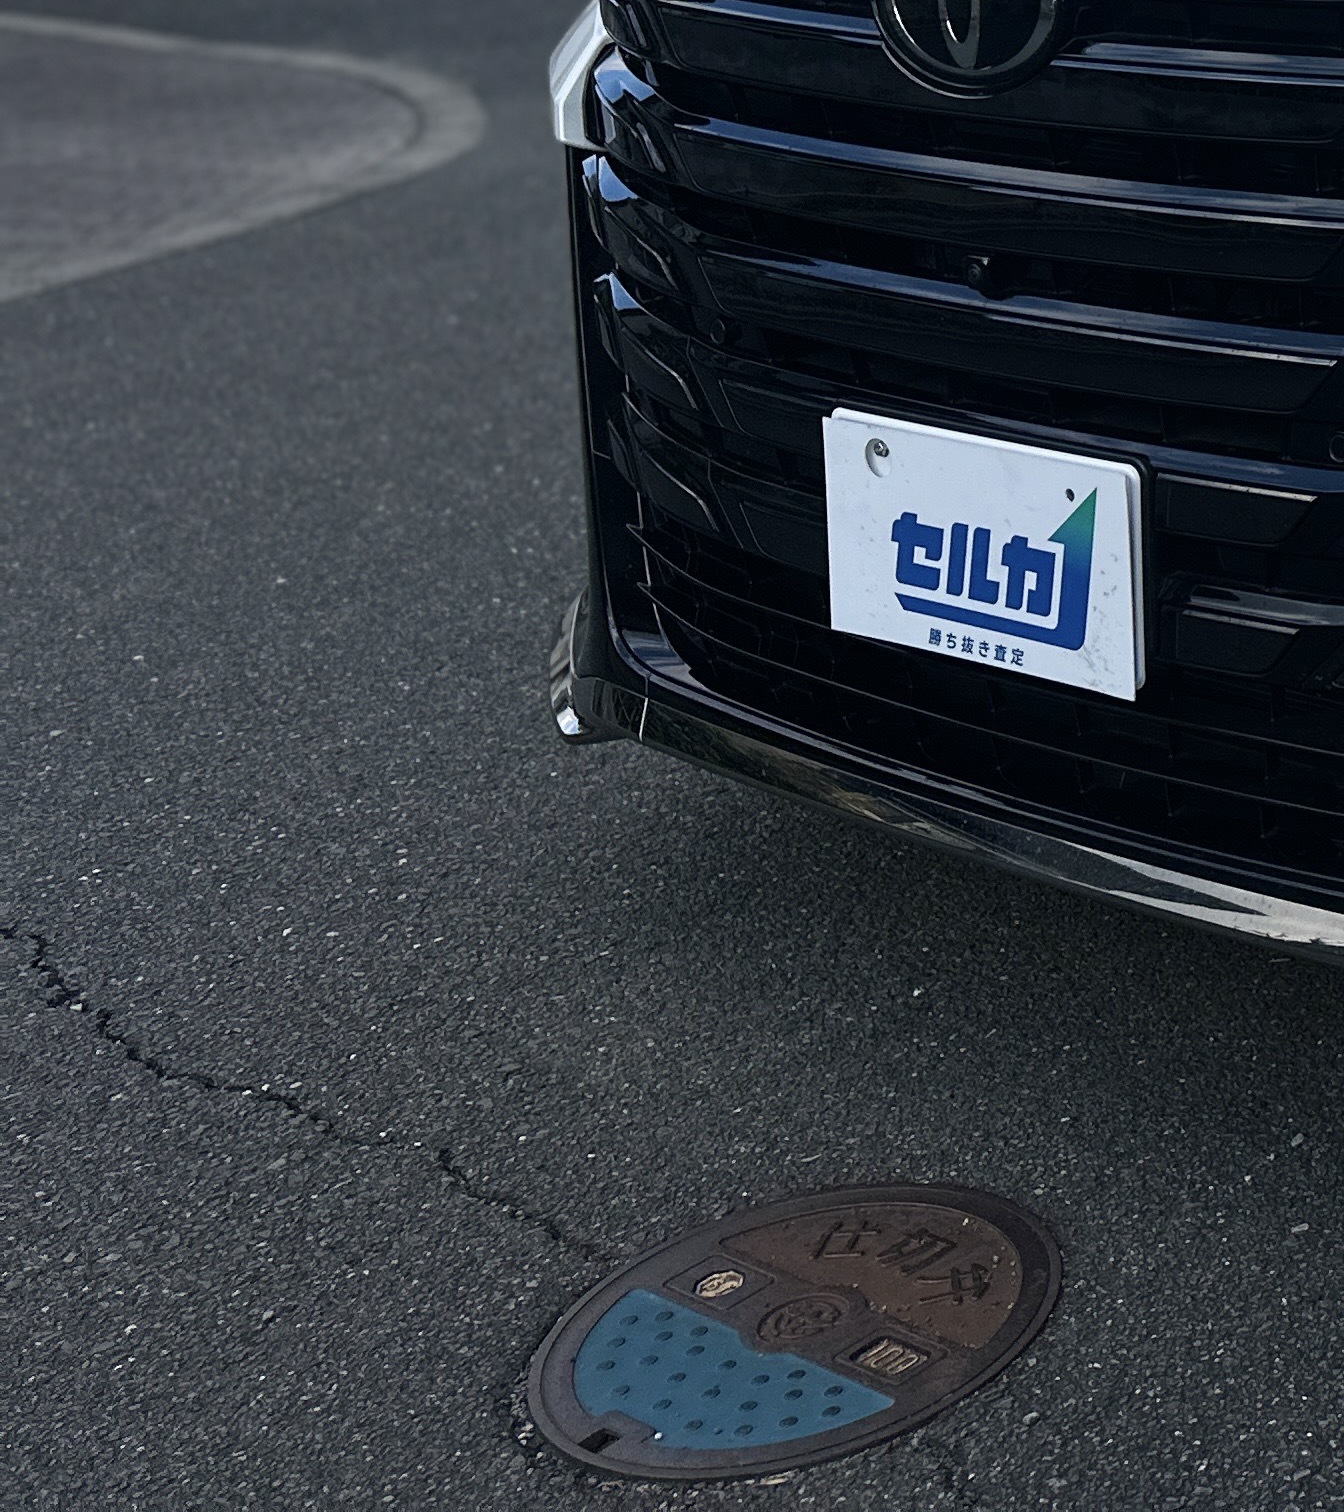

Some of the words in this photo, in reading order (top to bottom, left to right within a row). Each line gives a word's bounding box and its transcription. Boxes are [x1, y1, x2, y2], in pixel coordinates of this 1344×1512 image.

[891, 511, 1056, 617] セルカ
[928, 628, 1025, 666] 勝ち抜き査定
